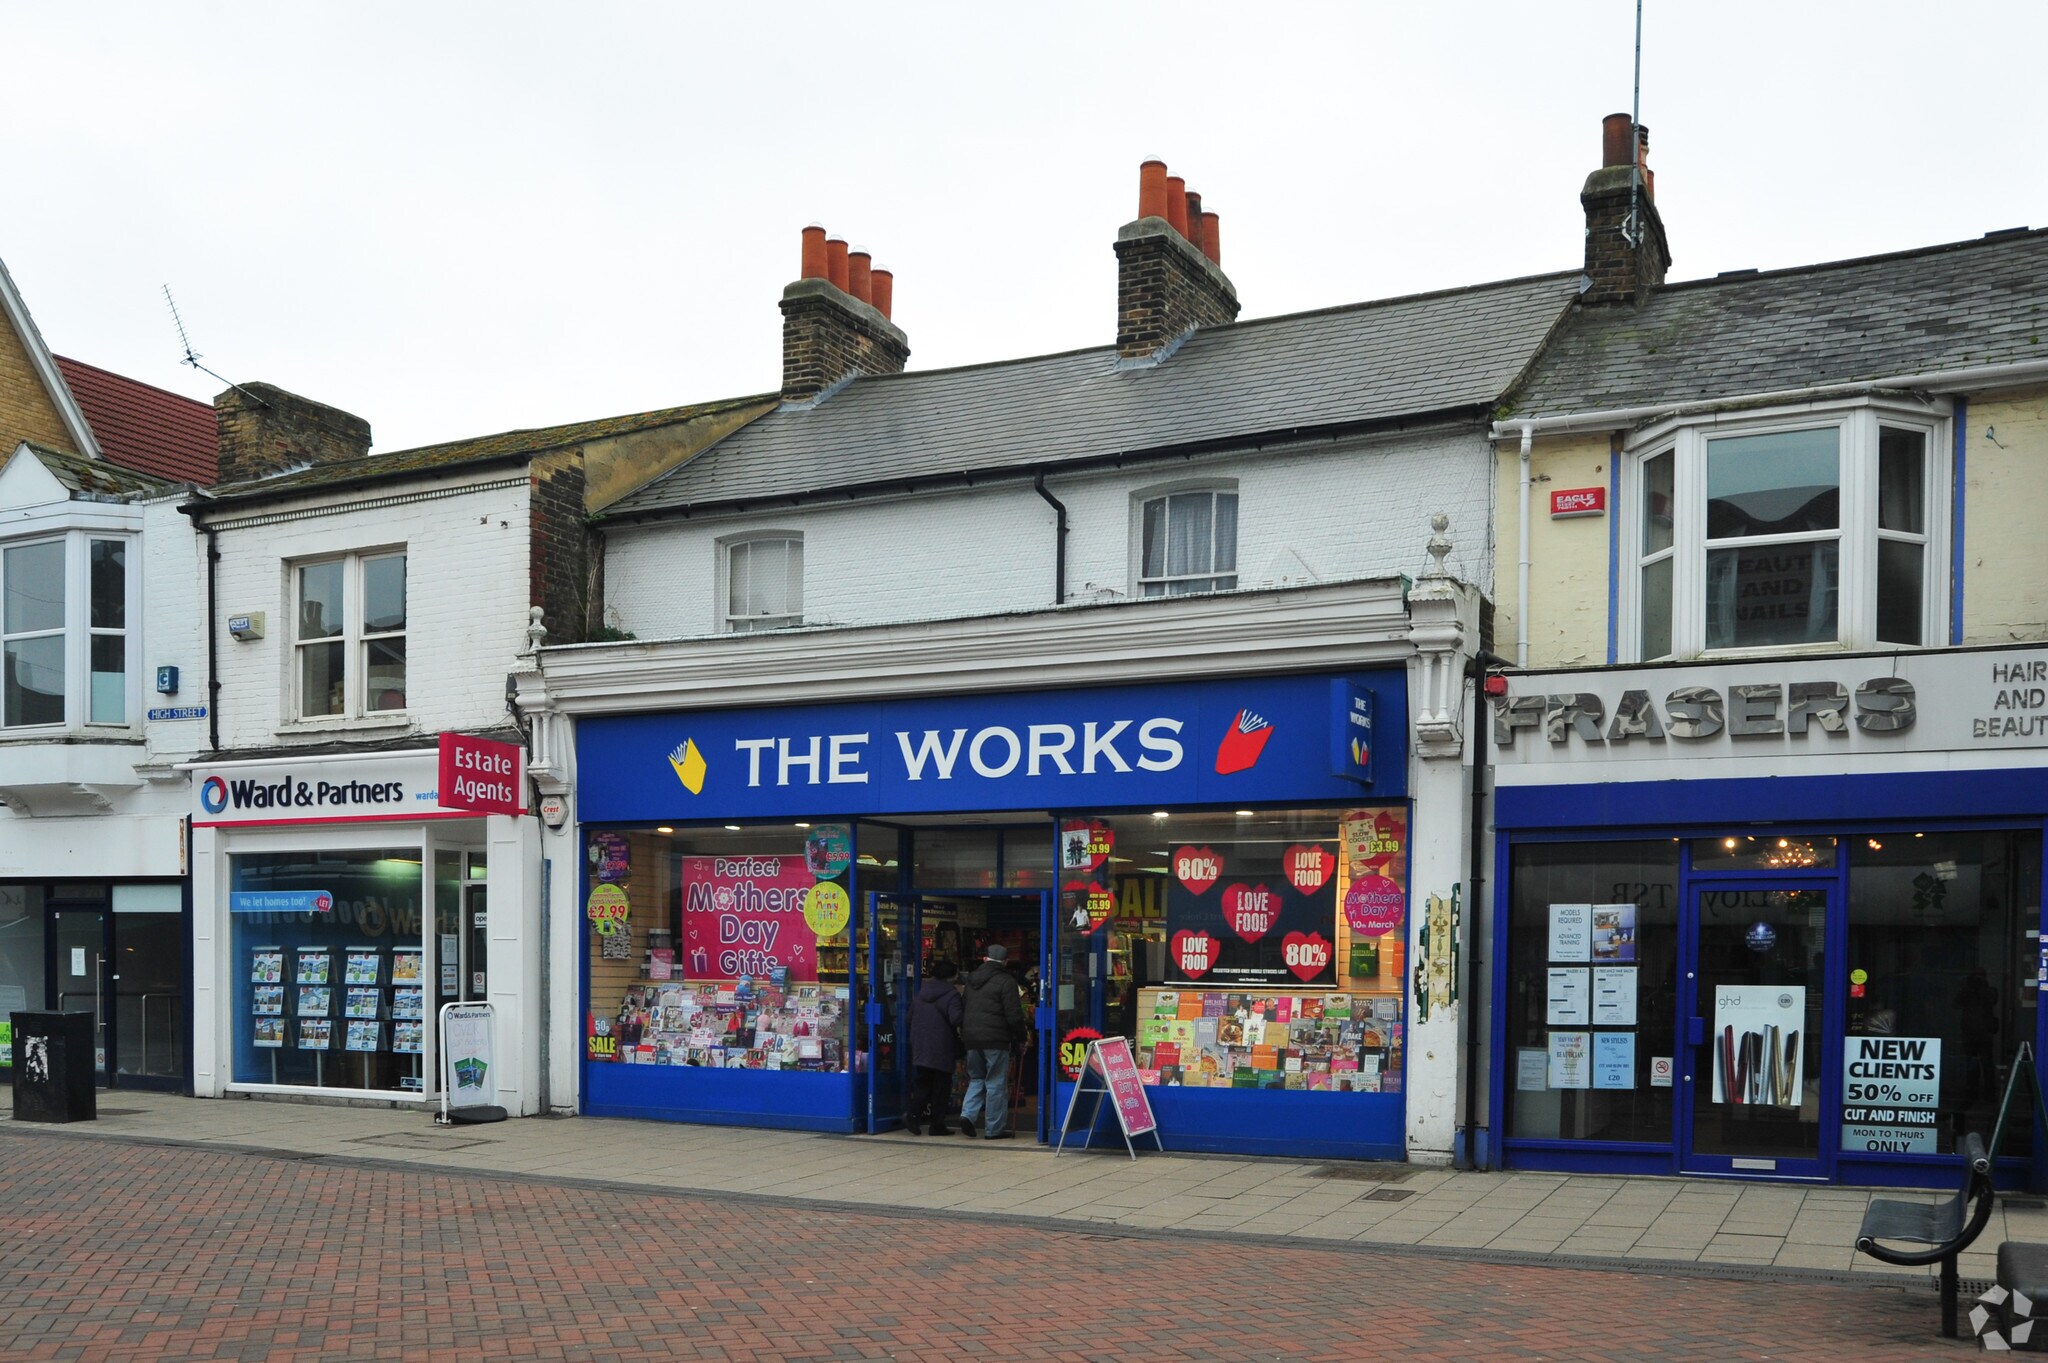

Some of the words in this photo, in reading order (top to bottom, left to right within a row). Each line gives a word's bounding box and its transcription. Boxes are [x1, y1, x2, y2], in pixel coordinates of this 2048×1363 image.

[1557, 493, 1594, 503] EAGLE
[1741, 579, 1802, 597] AND
[1993, 661, 2047, 683] HAIR
[1355, 697, 1366, 711] THE
[1994, 688, 2046, 710] AND
[151, 709, 171, 719] HIGH
[173, 707, 201, 718] STREET
[1494, 677, 1917, 744] FRASERS
[1350, 711, 1371, 729] WORKS
[1973, 715, 2048, 738] BEAUT
[735, 733, 869, 787] THE
[895, 717, 1184, 782] WORKS
[455, 747, 512, 775] Estate
[231, 776, 292, 809] Ward
[294, 782, 314, 806] &
[318, 780, 403, 805] Partners
[454, 775, 512, 803] Agents
[1086, 843, 1110, 853] £9.99
[1370, 840, 1399, 853] £3.99
[715, 857, 780, 877] Perfect
[1178, 858, 1217, 880] 80%
[1295, 852, 1322, 869] LOVE
[1294, 870, 1322, 886] FOOD
[240, 897, 252, 906] We
[253, 897, 263, 906] let
[264, 897, 289, 906] homes
[291, 896, 306, 906] too!
[319, 899, 329, 908] LET
[1087, 899, 1110, 910] £6.99
[1237, 891, 1269, 911] LOVE
[588, 905, 626, 918] £2.99
[1361, 904, 1388, 919] Day
[1236, 912, 1268, 933] FOOD
[1368, 920, 1395, 929] March
[720, 914, 779, 952] Day
[1183, 937, 1208, 953] LOVE
[719, 949, 778, 975] Gifts
[1182, 954, 1208, 970] FOOD
[1286, 943, 1327, 966] 80%
[1718, 995, 1741, 1009] ghd
[454, 1011, 467, 1019] Ward
[588, 1036, 616, 1053] SALE
[1860, 1040, 1926, 1060] NEW
[1849, 1062, 1935, 1080] CLIENTS
[1848, 1084, 1902, 1101] 50%
[1908, 1093, 1934, 1102] OFF
[1845, 1108, 1867, 1120] CUT
[1869, 1109, 1895, 1121] AND
[1898, 1110, 1935, 1123] FINISH
[1853, 1129, 1876, 1137] MON
[1879, 1130, 1891, 1138] TO
[1895, 1131, 1925, 1139] THURS
[1866, 1140, 1911, 1152] ONLY
